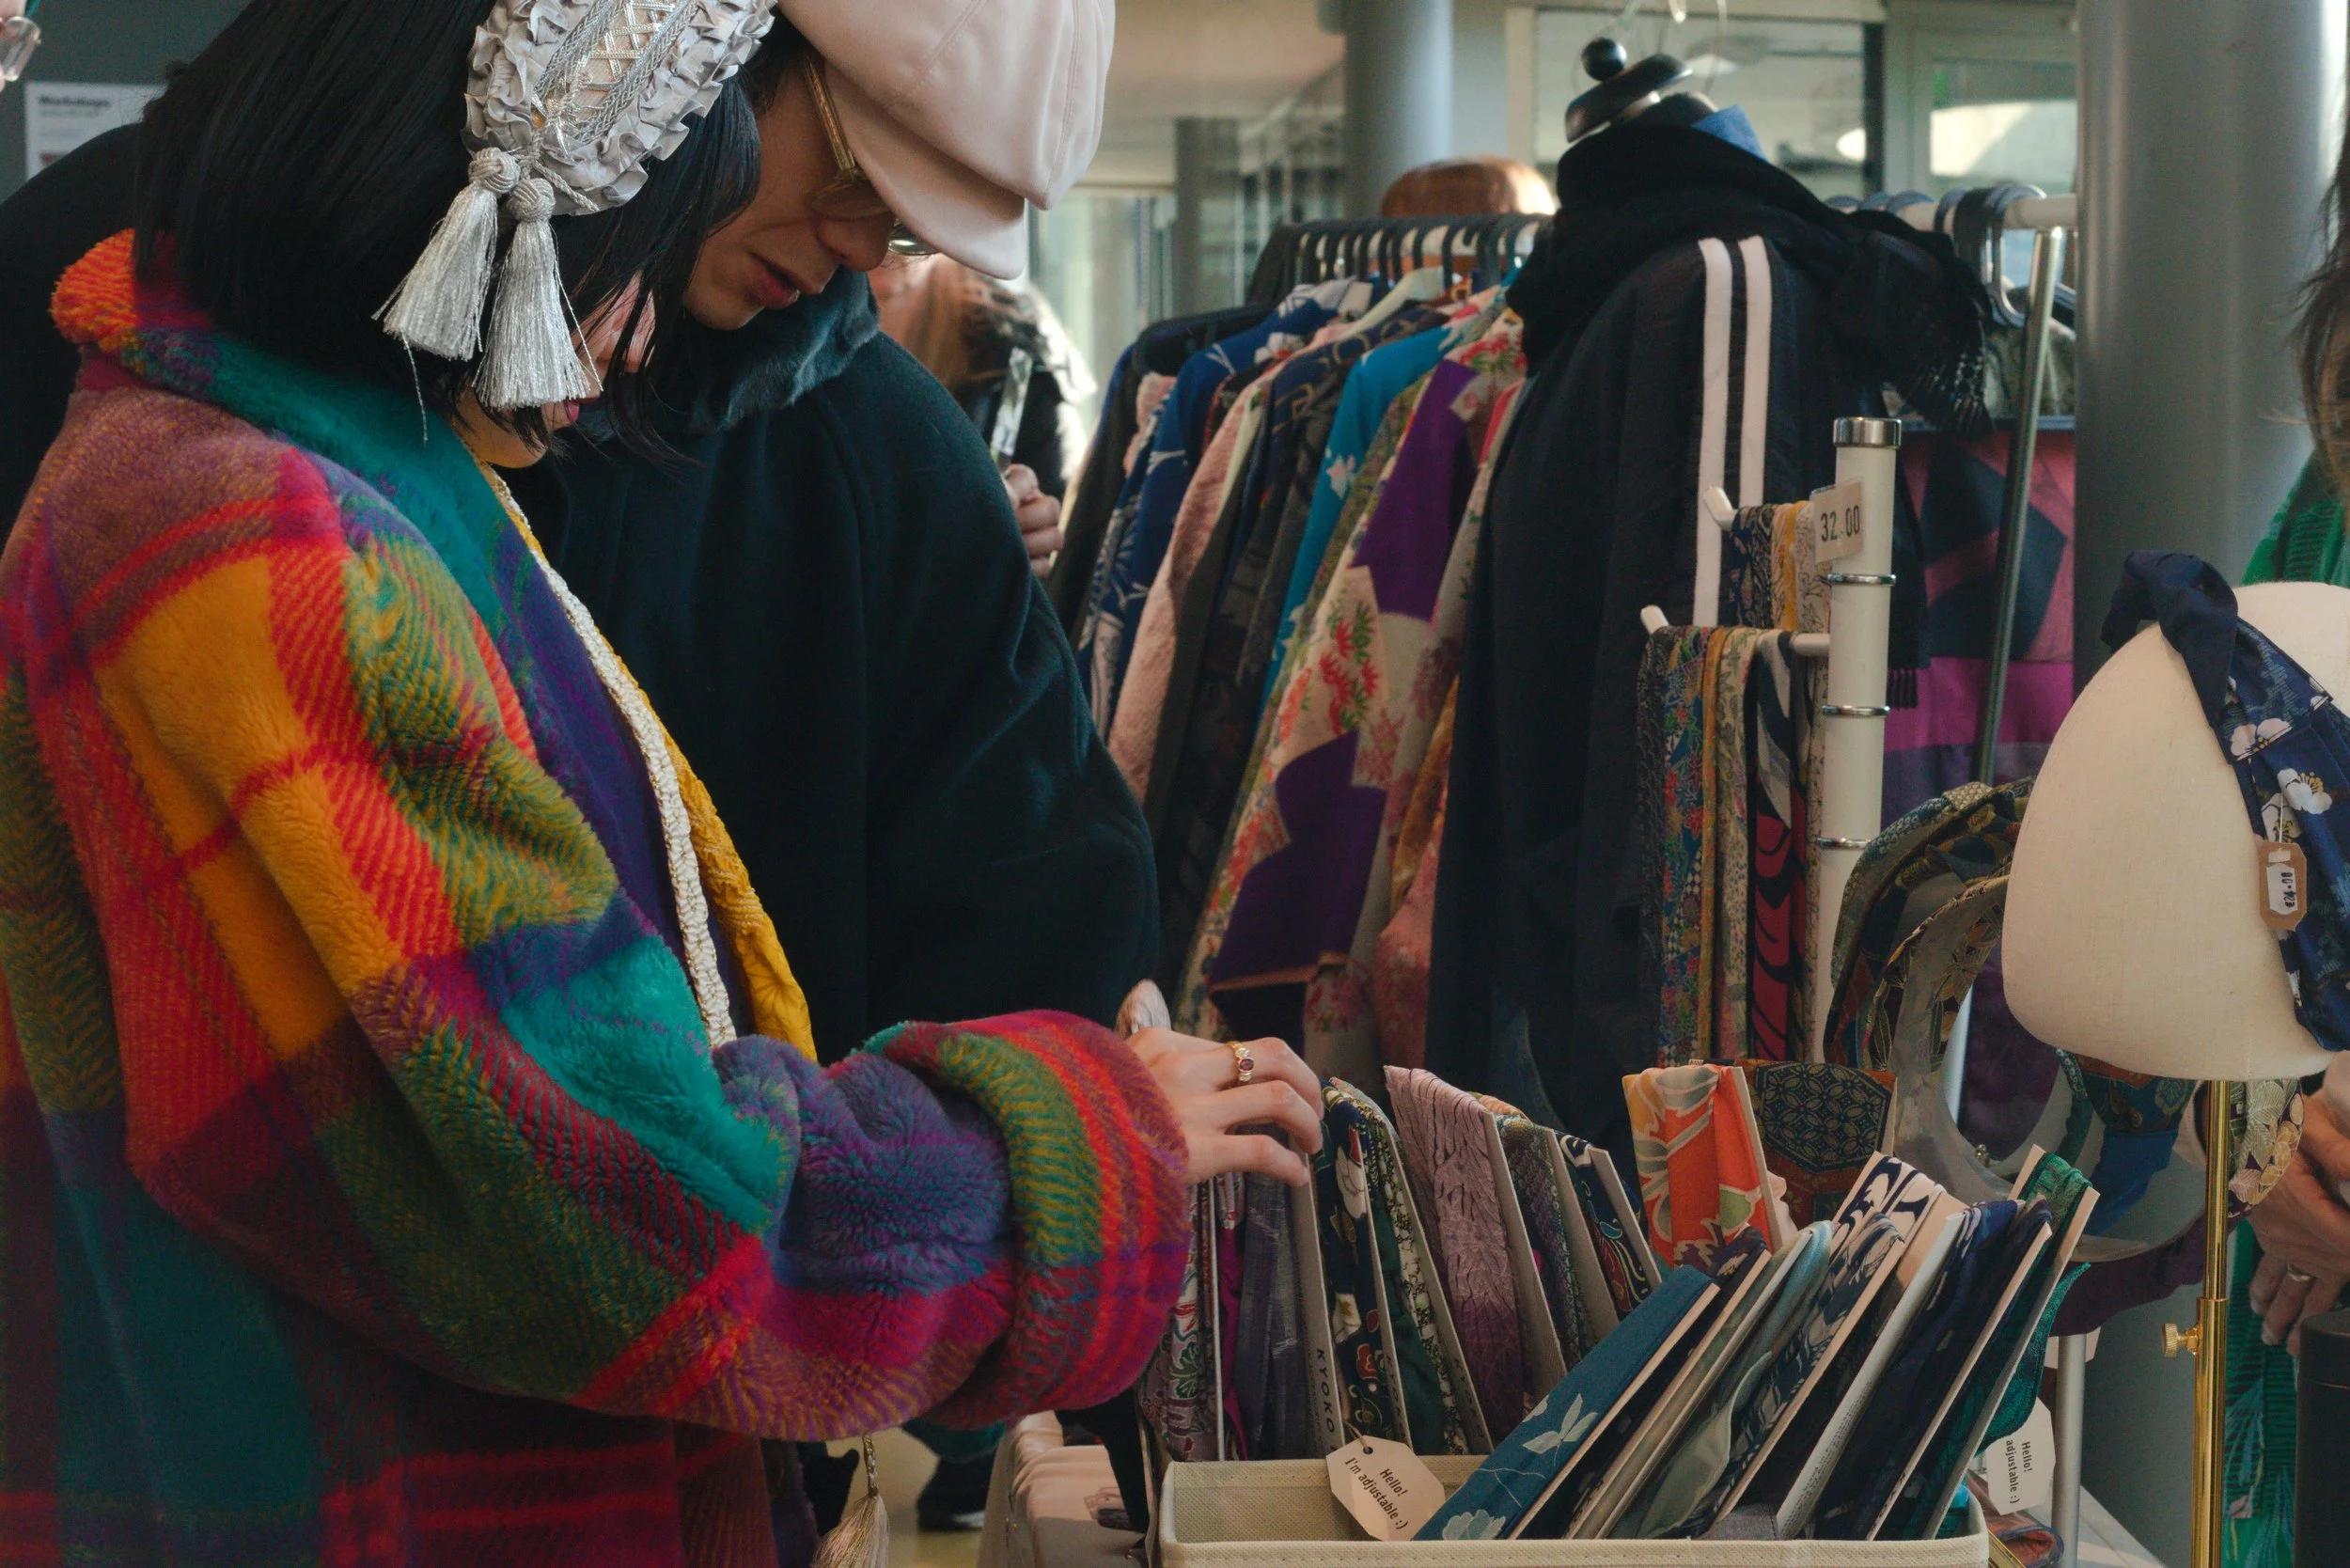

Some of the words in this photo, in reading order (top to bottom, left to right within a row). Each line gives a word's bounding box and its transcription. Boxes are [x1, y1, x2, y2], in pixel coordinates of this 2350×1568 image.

[1821, 505, 1860, 542] 32.00
[1317, 1348, 1335, 1434] KYOKO
[2005, 1439, 2020, 1493] adjustable
[2021, 1441, 2033, 1473] Hello!
[1345, 1457, 1362, 1475] I'm
[1357, 1473, 1399, 1520] adjustable
[1379, 1468, 1408, 1497] Hello!
